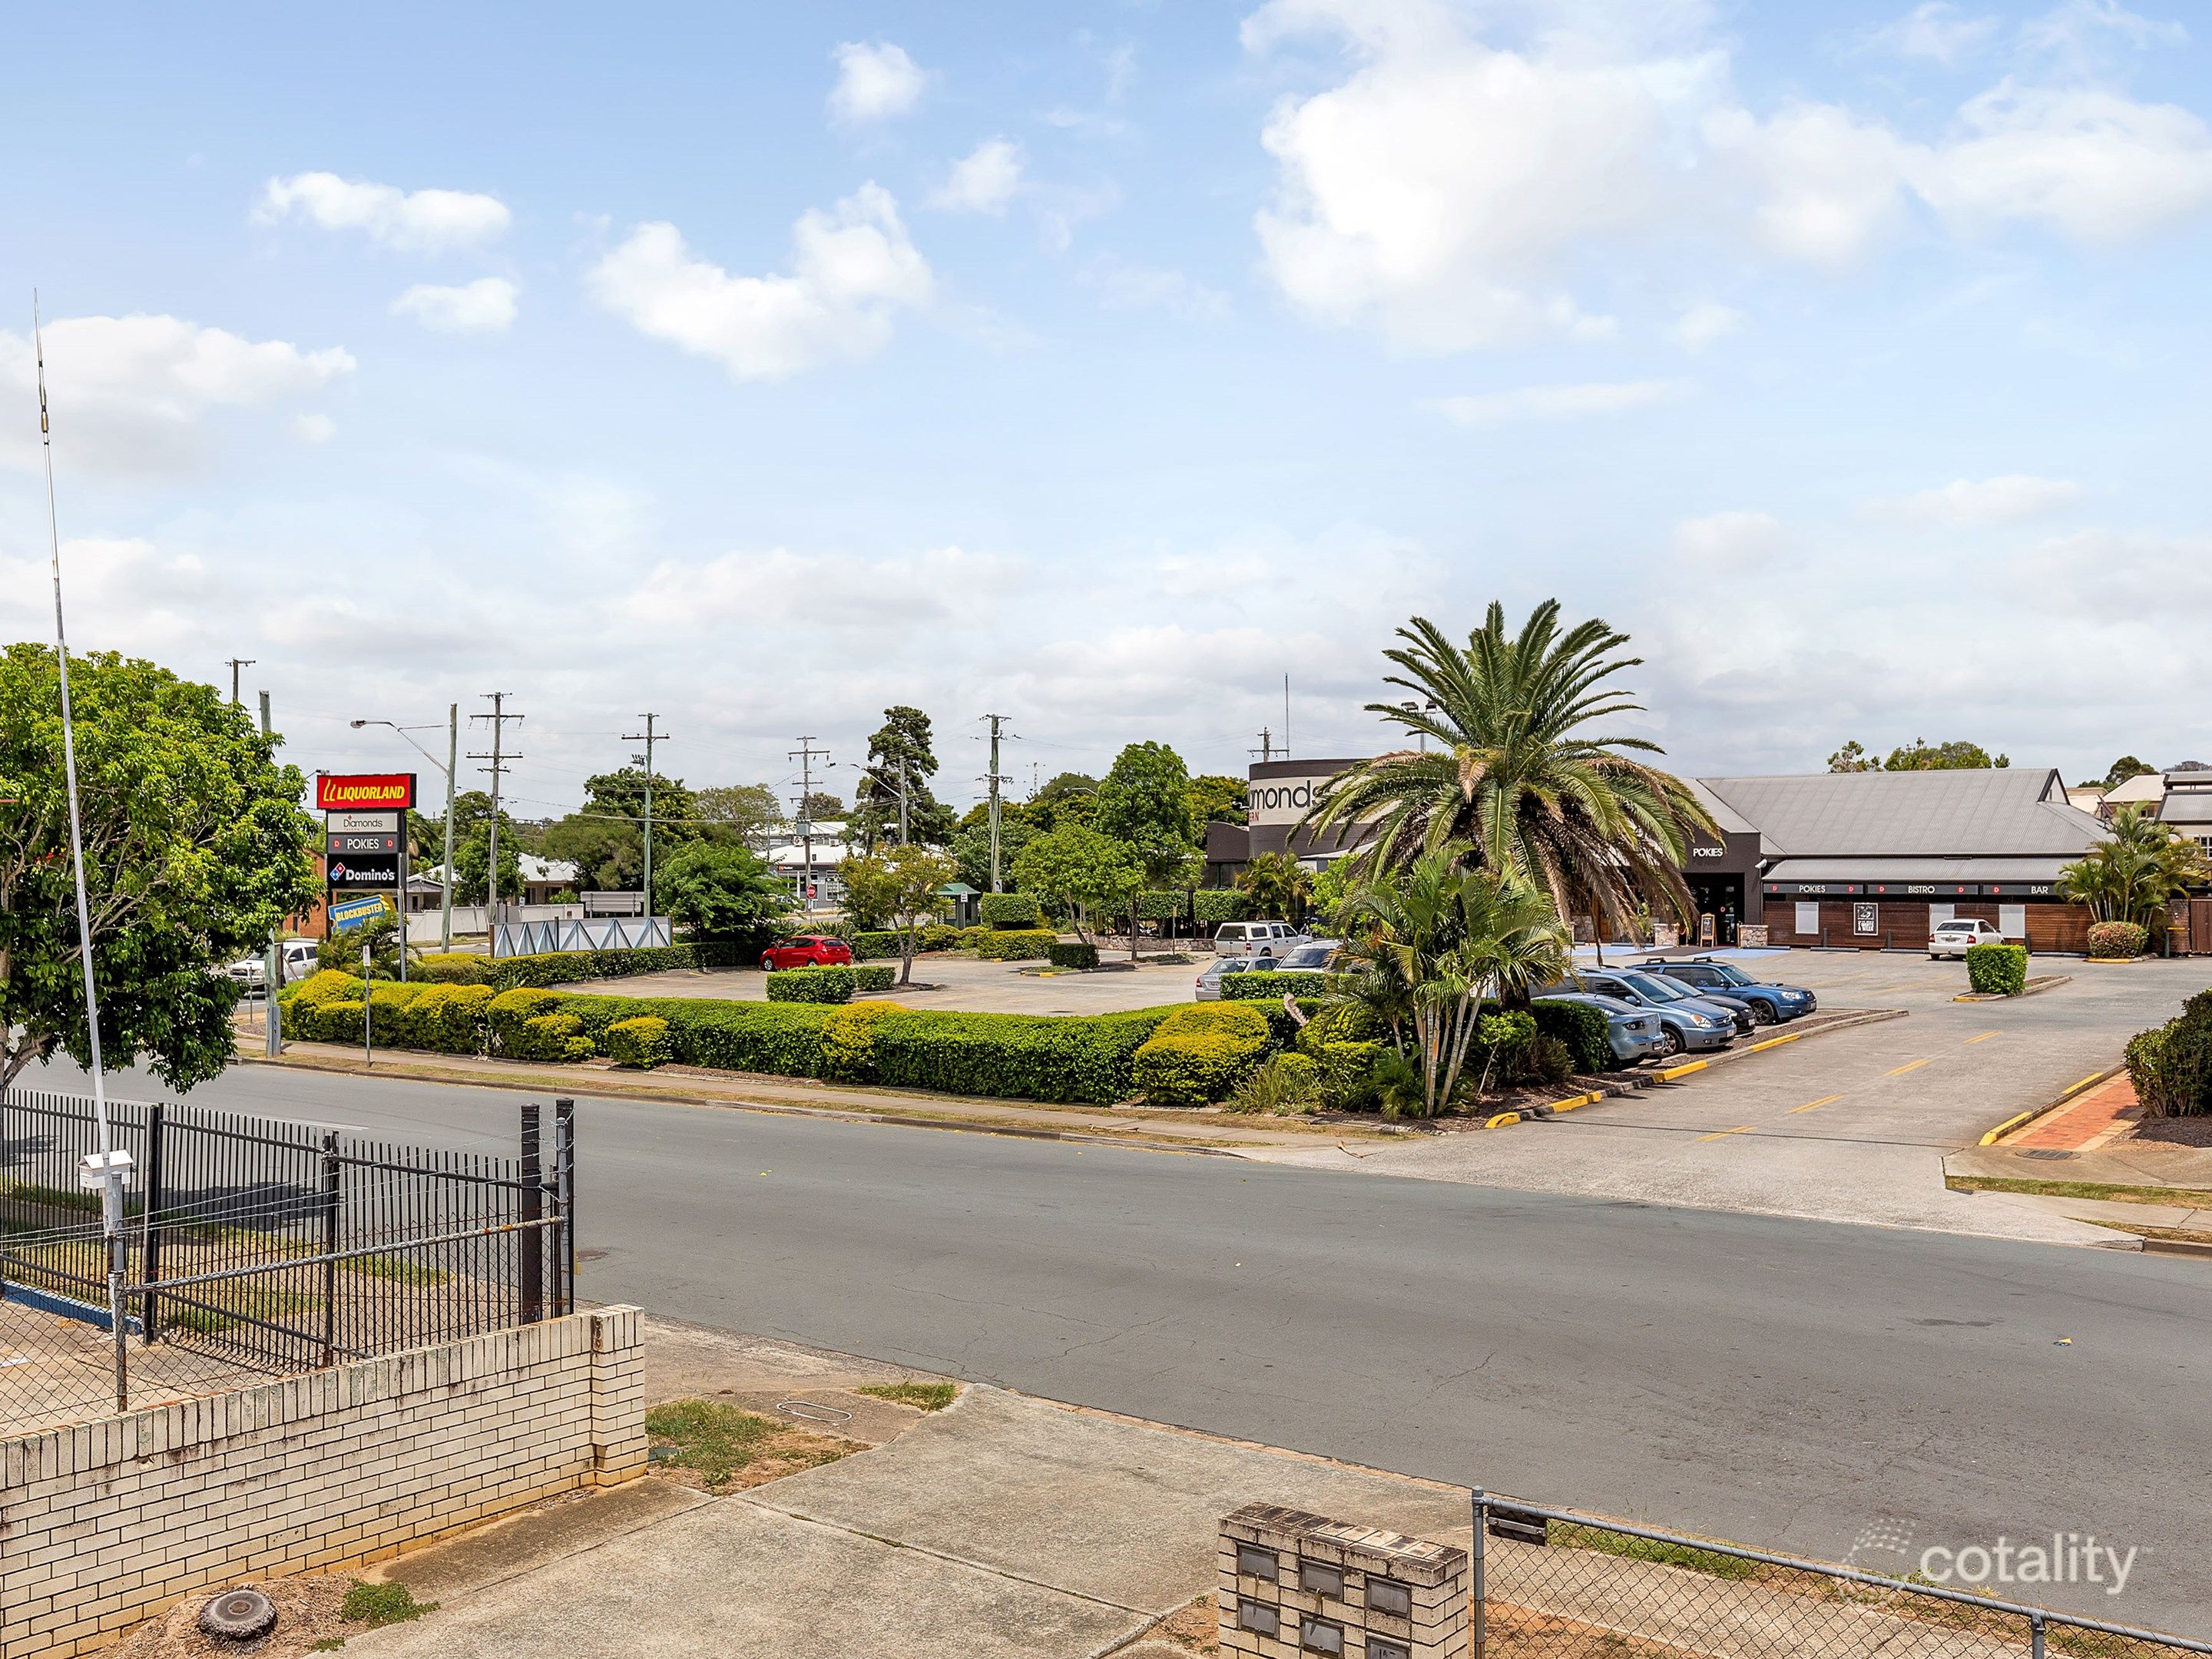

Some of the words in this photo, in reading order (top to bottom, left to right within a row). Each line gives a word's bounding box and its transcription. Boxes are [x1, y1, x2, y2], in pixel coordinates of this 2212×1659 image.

[336, 786, 405, 802] LIQUORLAND
[343, 818, 383, 828] Diamonds
[347, 838, 379, 849] POKIES
[1693, 847, 1724, 857] POKIES
[346, 868, 396, 881] Domino's
[1799, 885, 1826, 893] POKIES
[1908, 886, 1936, 894] BISTRO
[2031, 886, 2049, 894] BAR
[335, 902, 382, 922] BLOCKBUSTER
